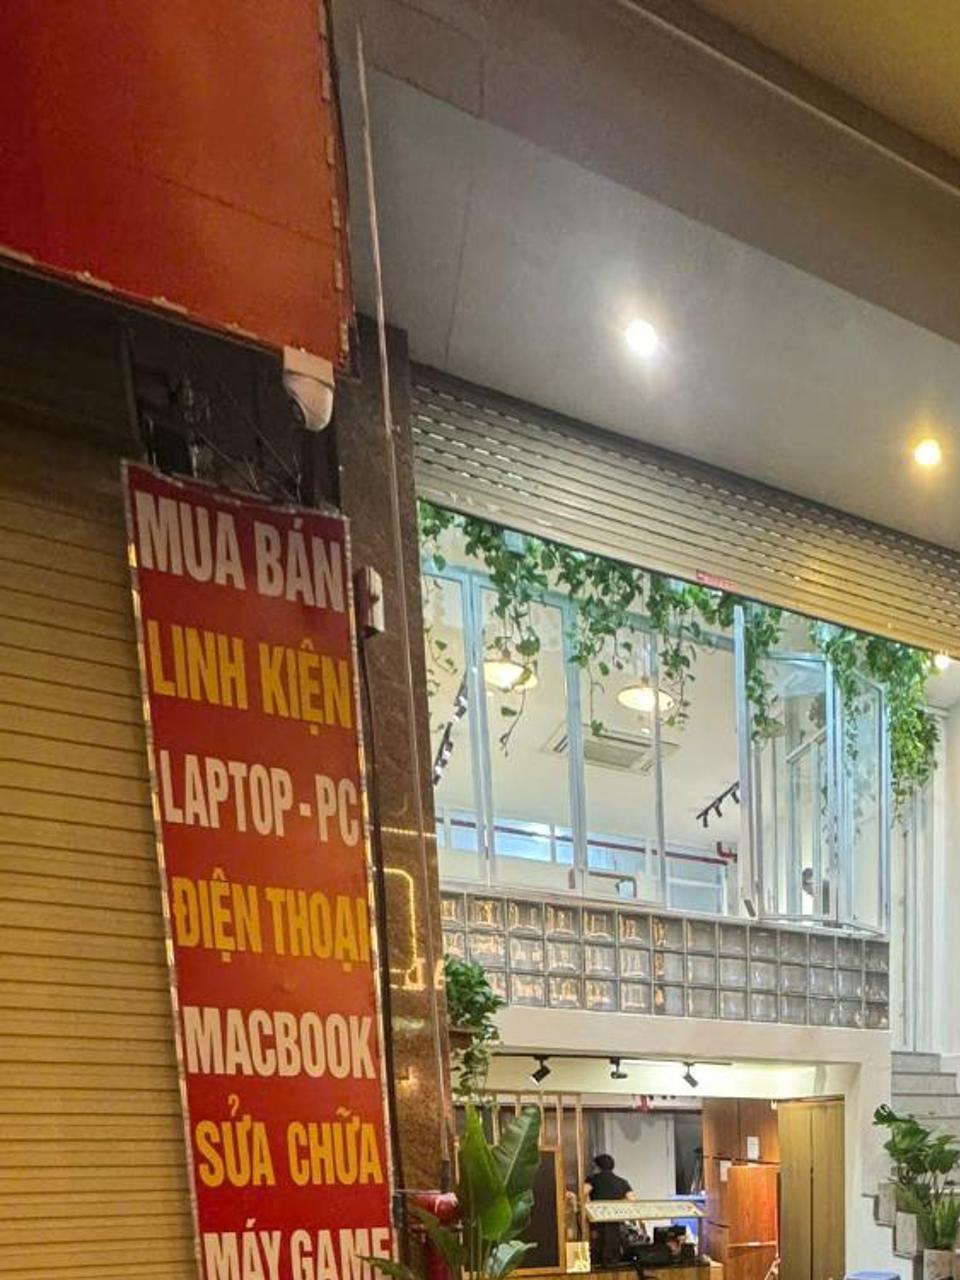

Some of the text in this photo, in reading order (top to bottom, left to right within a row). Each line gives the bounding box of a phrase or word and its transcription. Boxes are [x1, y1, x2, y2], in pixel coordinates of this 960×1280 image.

[135, 490, 346, 613] MUA BÁN
[146, 619, 353, 736] LINH KIỆN
[172, 867, 371, 972] ĐIỆN THOẠI
[182, 1005, 376, 1080] MACBOOK
[195, 1094, 384, 1188] SỬA CHỮA
